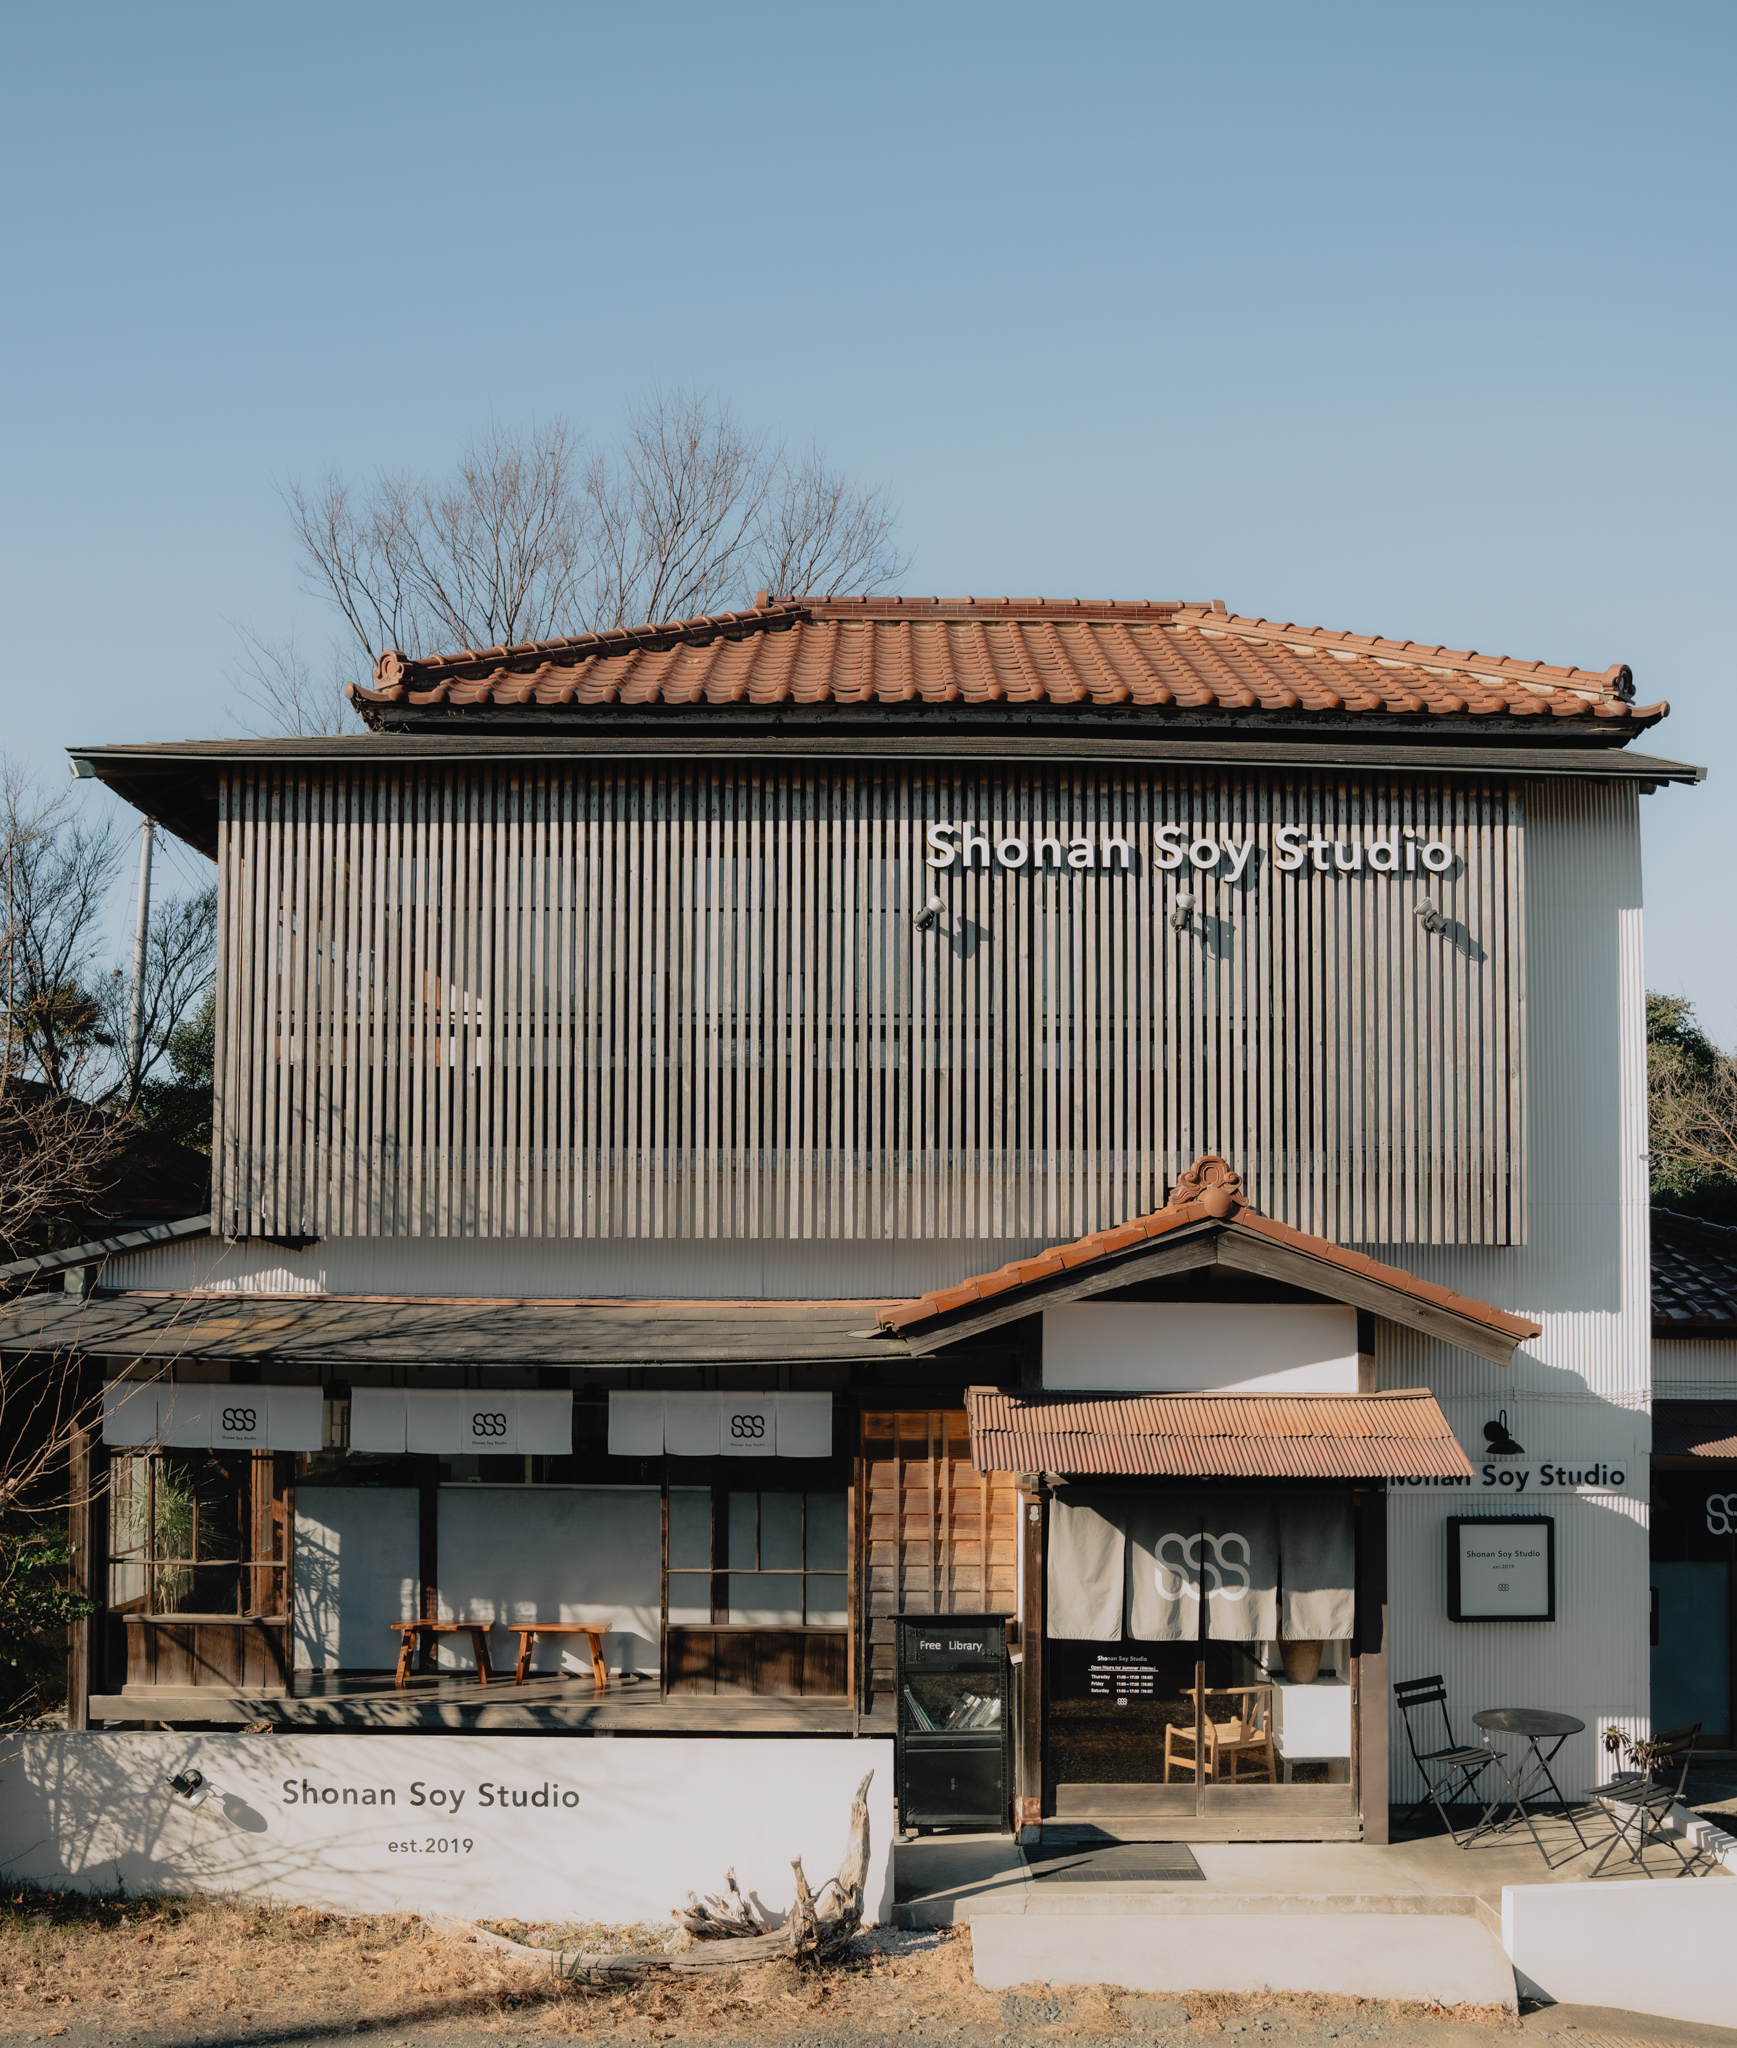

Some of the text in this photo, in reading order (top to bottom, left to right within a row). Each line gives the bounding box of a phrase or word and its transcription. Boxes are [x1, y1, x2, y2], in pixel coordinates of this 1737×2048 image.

[926, 823, 1452, 882] Shonan Soy Studio
[1482, 1464, 1529, 1492] Soy
[1540, 1463, 1625, 1486] Studio
[1466, 1550, 1495, 1558] Shonan
[1497, 1550, 1512, 1559] Soy
[920, 1640, 982, 1652] Free Library
[282, 1779, 580, 1814] Shonan Soy Studio
[388, 1838, 474, 1853] est.2019
